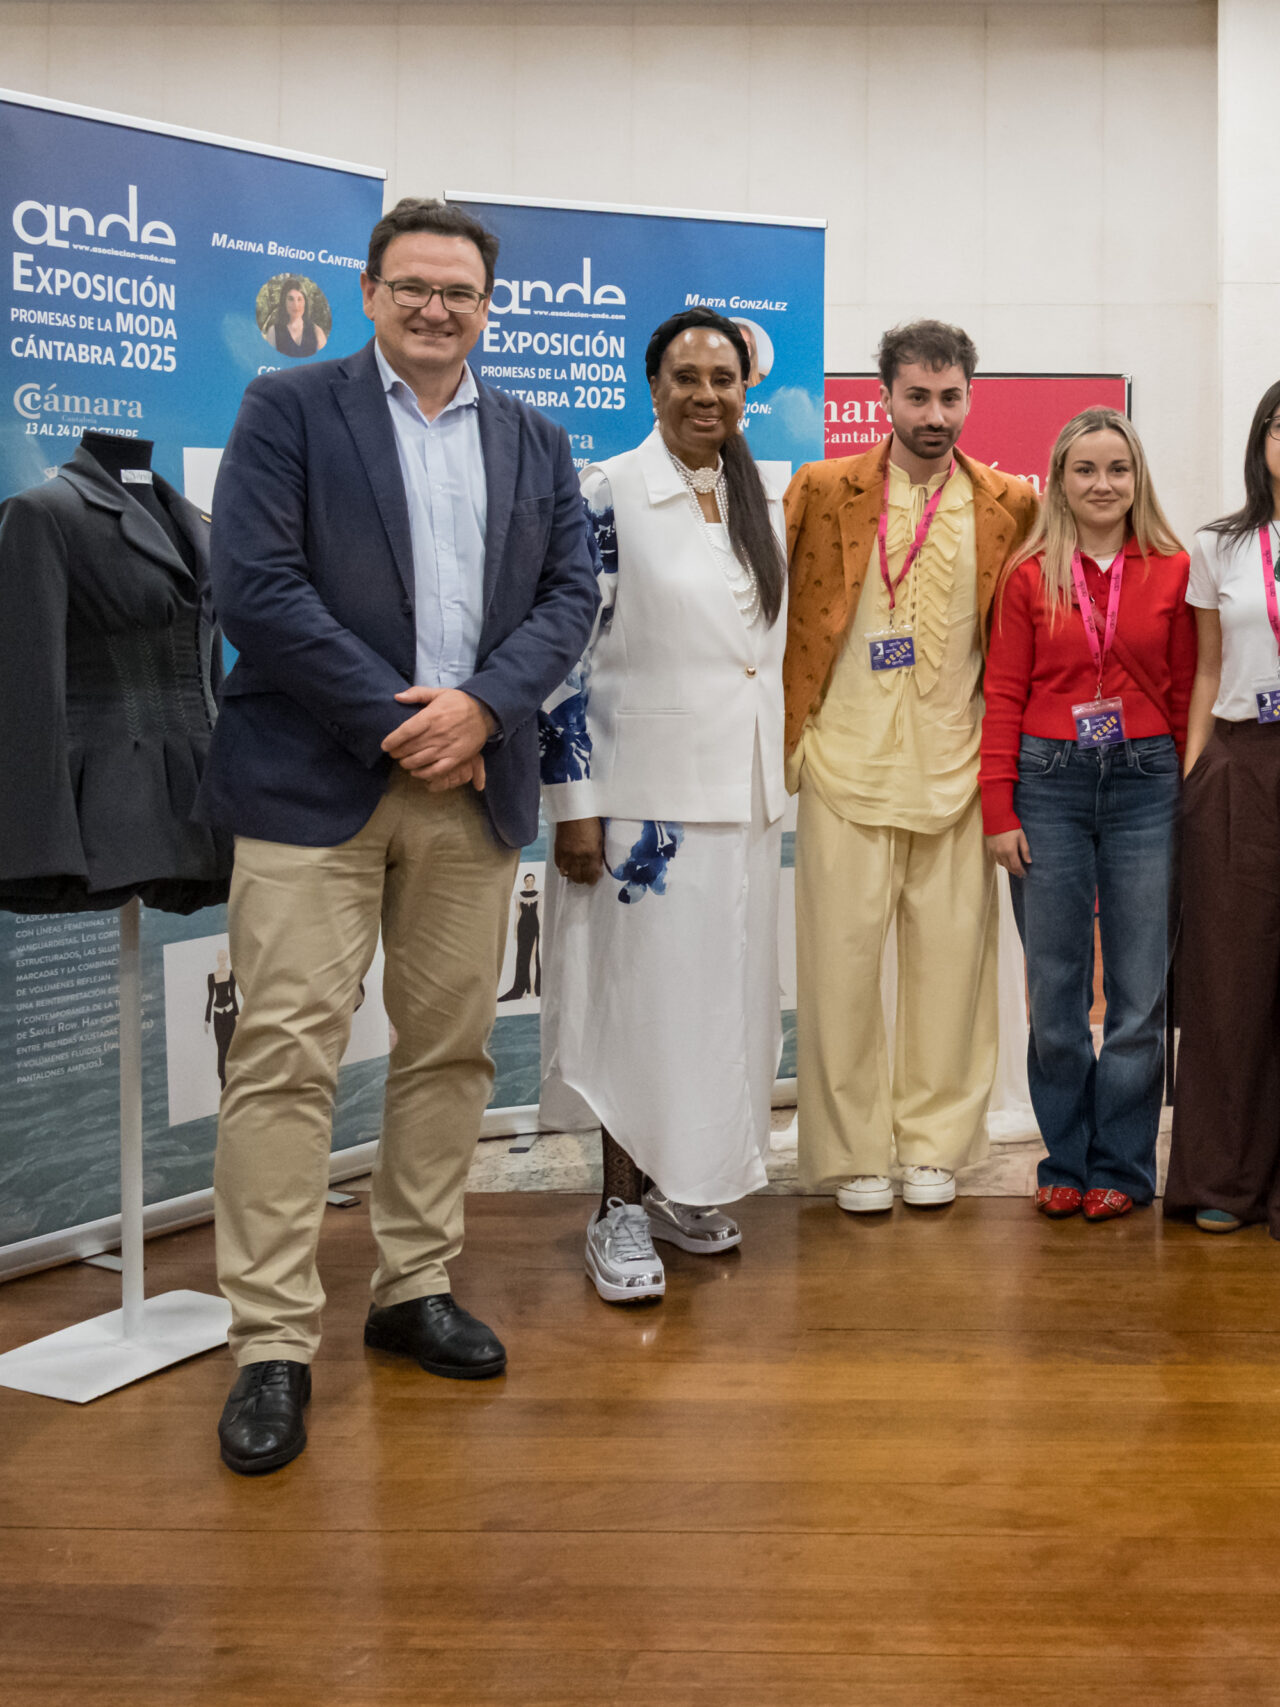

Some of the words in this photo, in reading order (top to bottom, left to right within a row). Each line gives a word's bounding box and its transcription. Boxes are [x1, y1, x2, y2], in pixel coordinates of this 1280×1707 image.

[12, 184, 177, 249] ande
[72, 243, 177, 265] www.asociacion-ande.com
[211, 232, 264, 254] MARINA
[267, 241, 315, 261] BRÍGIDO
[318, 250, 366, 270] CANTERO
[13, 252, 176, 311] EXPOSICIÓN
[488, 257, 626, 315] ande
[685, 293, 726, 308] MARTA
[729, 296, 788, 311] GONZÁLEZ
[11, 307, 76, 329] PROMESAS
[79, 315, 95, 330] DE
[97, 318, 113, 332] LA
[115, 312, 178, 340] MODA
[533, 310, 626, 320] www.asociacion-ande.com
[483, 321, 625, 358] EXPOSICIÓN
[11, 334, 116, 366] CÁNTABRA
[121, 340, 177, 373] 2025
[481, 365, 536, 379] PROMESAS
[538, 368, 552, 379] DE
[554, 369, 567, 380] LA
[570, 362, 627, 383] MODA
[574, 386, 626, 410] 2025
[25, 422, 38, 435] 13
[39, 424, 54, 436] AL
[57, 424, 70, 437] 24
[16, 929, 34, 938] CON
[64, 917, 104, 931] FEMENINAS
[81, 933, 97, 943] LOS
[83, 947, 97, 957] LAS
[16, 968, 59, 982] MARCADAS
[67, 965, 76, 974] LA
[16, 988, 27, 997] DE
[16, 1003, 34, 1012] UNA
